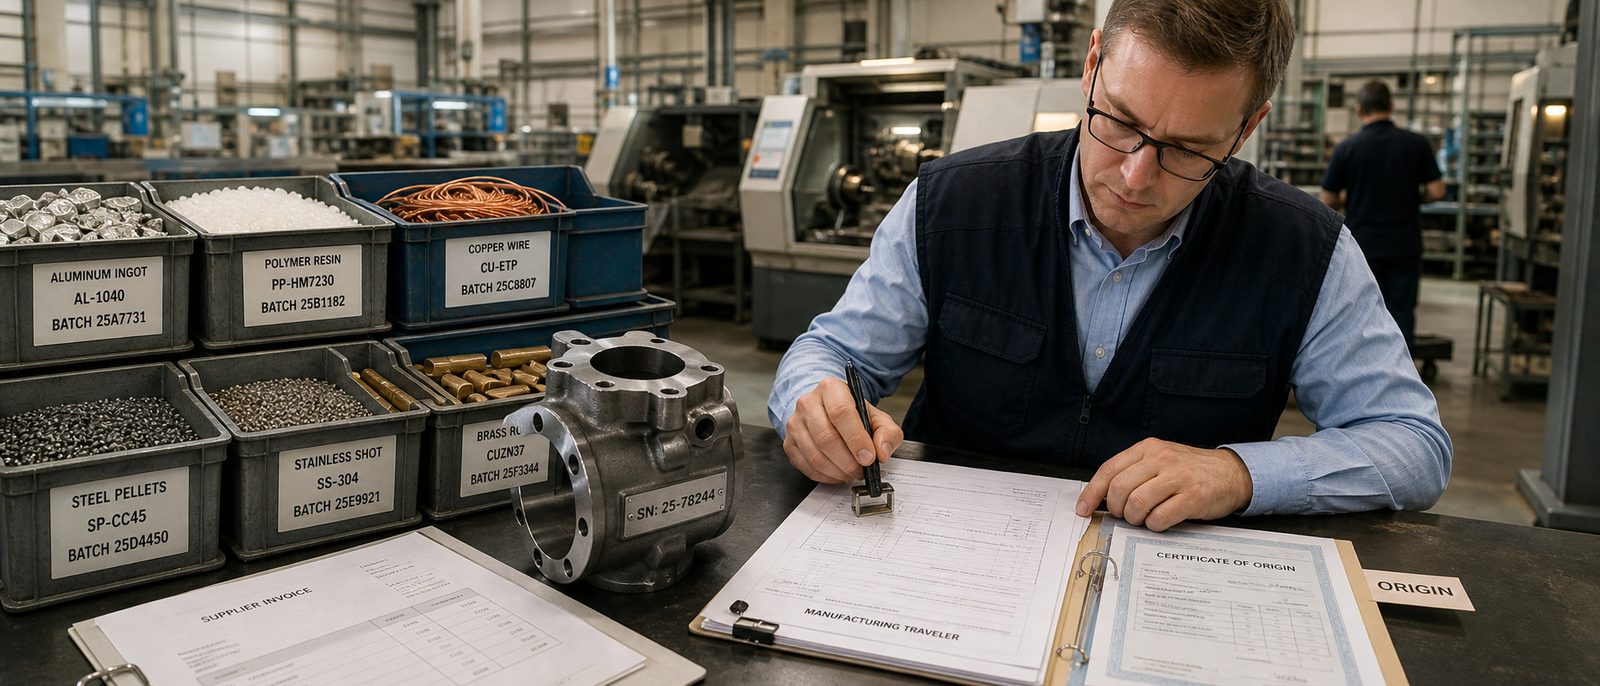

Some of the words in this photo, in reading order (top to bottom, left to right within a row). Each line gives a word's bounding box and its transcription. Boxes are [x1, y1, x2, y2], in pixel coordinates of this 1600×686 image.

[469, 242, 504, 254] COPPER
[507, 240, 529, 250] WIRE
[265, 257, 310, 269] POLYMER
[314, 255, 341, 265] RESIN
[481, 260, 517, 273] CU-ETP
[51, 269, 111, 283] ALUMINUM
[115, 267, 147, 278] INGOT
[272, 275, 334, 290] PP-HM7230
[462, 283, 492, 295] BATCH
[497, 278, 536, 291] 25C8807
[74, 289, 124, 305] AL-1040
[262, 300, 296, 313] BATCH
[301, 295, 345, 309] 25B1182
[53, 316, 91, 331] BATCH
[97, 311, 146, 327] 25A7731
[477, 428, 506, 441] BRASS
[294, 452, 352, 470] STAINLESS
[355, 447, 383, 460] SHOT
[487, 445, 524, 461] CUZN37
[318, 472, 359, 489] SS-304
[471, 470, 500, 485] BATCH
[503, 463, 539, 479] 25F3344
[72, 491, 110, 508] STEEL
[115, 481, 166, 501] PELLETS
[294, 500, 330, 517] BATCH
[335, 491, 381, 510] 25E9921
[637, 505, 657, 520] SN:
[661, 488, 716, 514] 25-78244
[88, 509, 146, 532] SP-CC45
[69, 542, 109, 562] BATCH
[115, 530, 168, 553] 25D4450
[1157, 553, 1229, 564] CERTIFICATE
[1254, 562, 1295, 571] ORIGIN
[1378, 582, 1453, 596] ORIGIN
[201, 602, 261, 623] SUPPLIER
[262, 587, 313, 604] INVOICE
[805, 609, 899, 629] MANUFACTURING
[905, 625, 959, 640] TRAVELER
